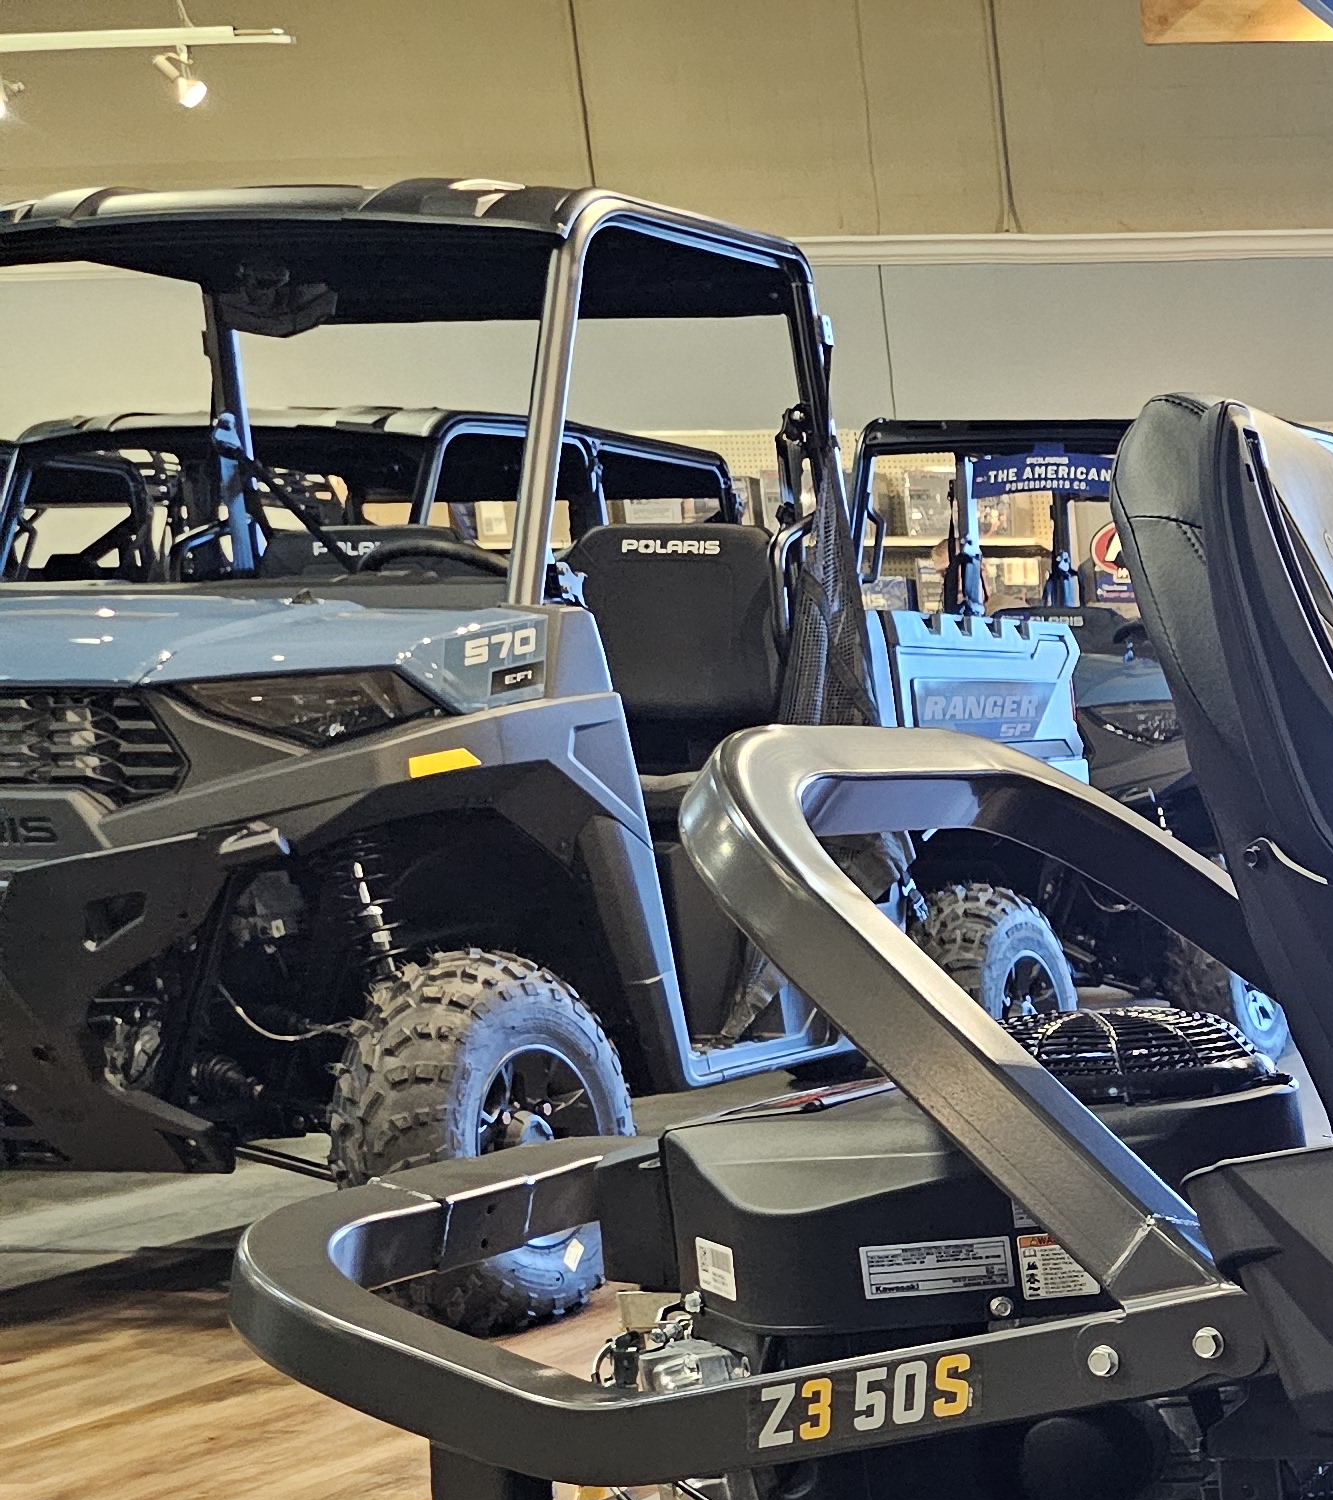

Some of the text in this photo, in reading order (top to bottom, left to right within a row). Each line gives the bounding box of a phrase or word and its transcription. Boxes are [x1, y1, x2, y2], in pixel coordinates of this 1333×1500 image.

[988, 468, 1018, 484] THE
[1022, 465, 1112, 482] AMERICAN
[621, 539, 720, 555] POLARIS
[464, 627, 537, 667] 570
[923, 695, 1040, 721] RANGER
[1000, 723, 1032, 737] SP
[875, 1282, 919, 1294] Kawasaki
[758, 1353, 973, 1450] Z3 50S
